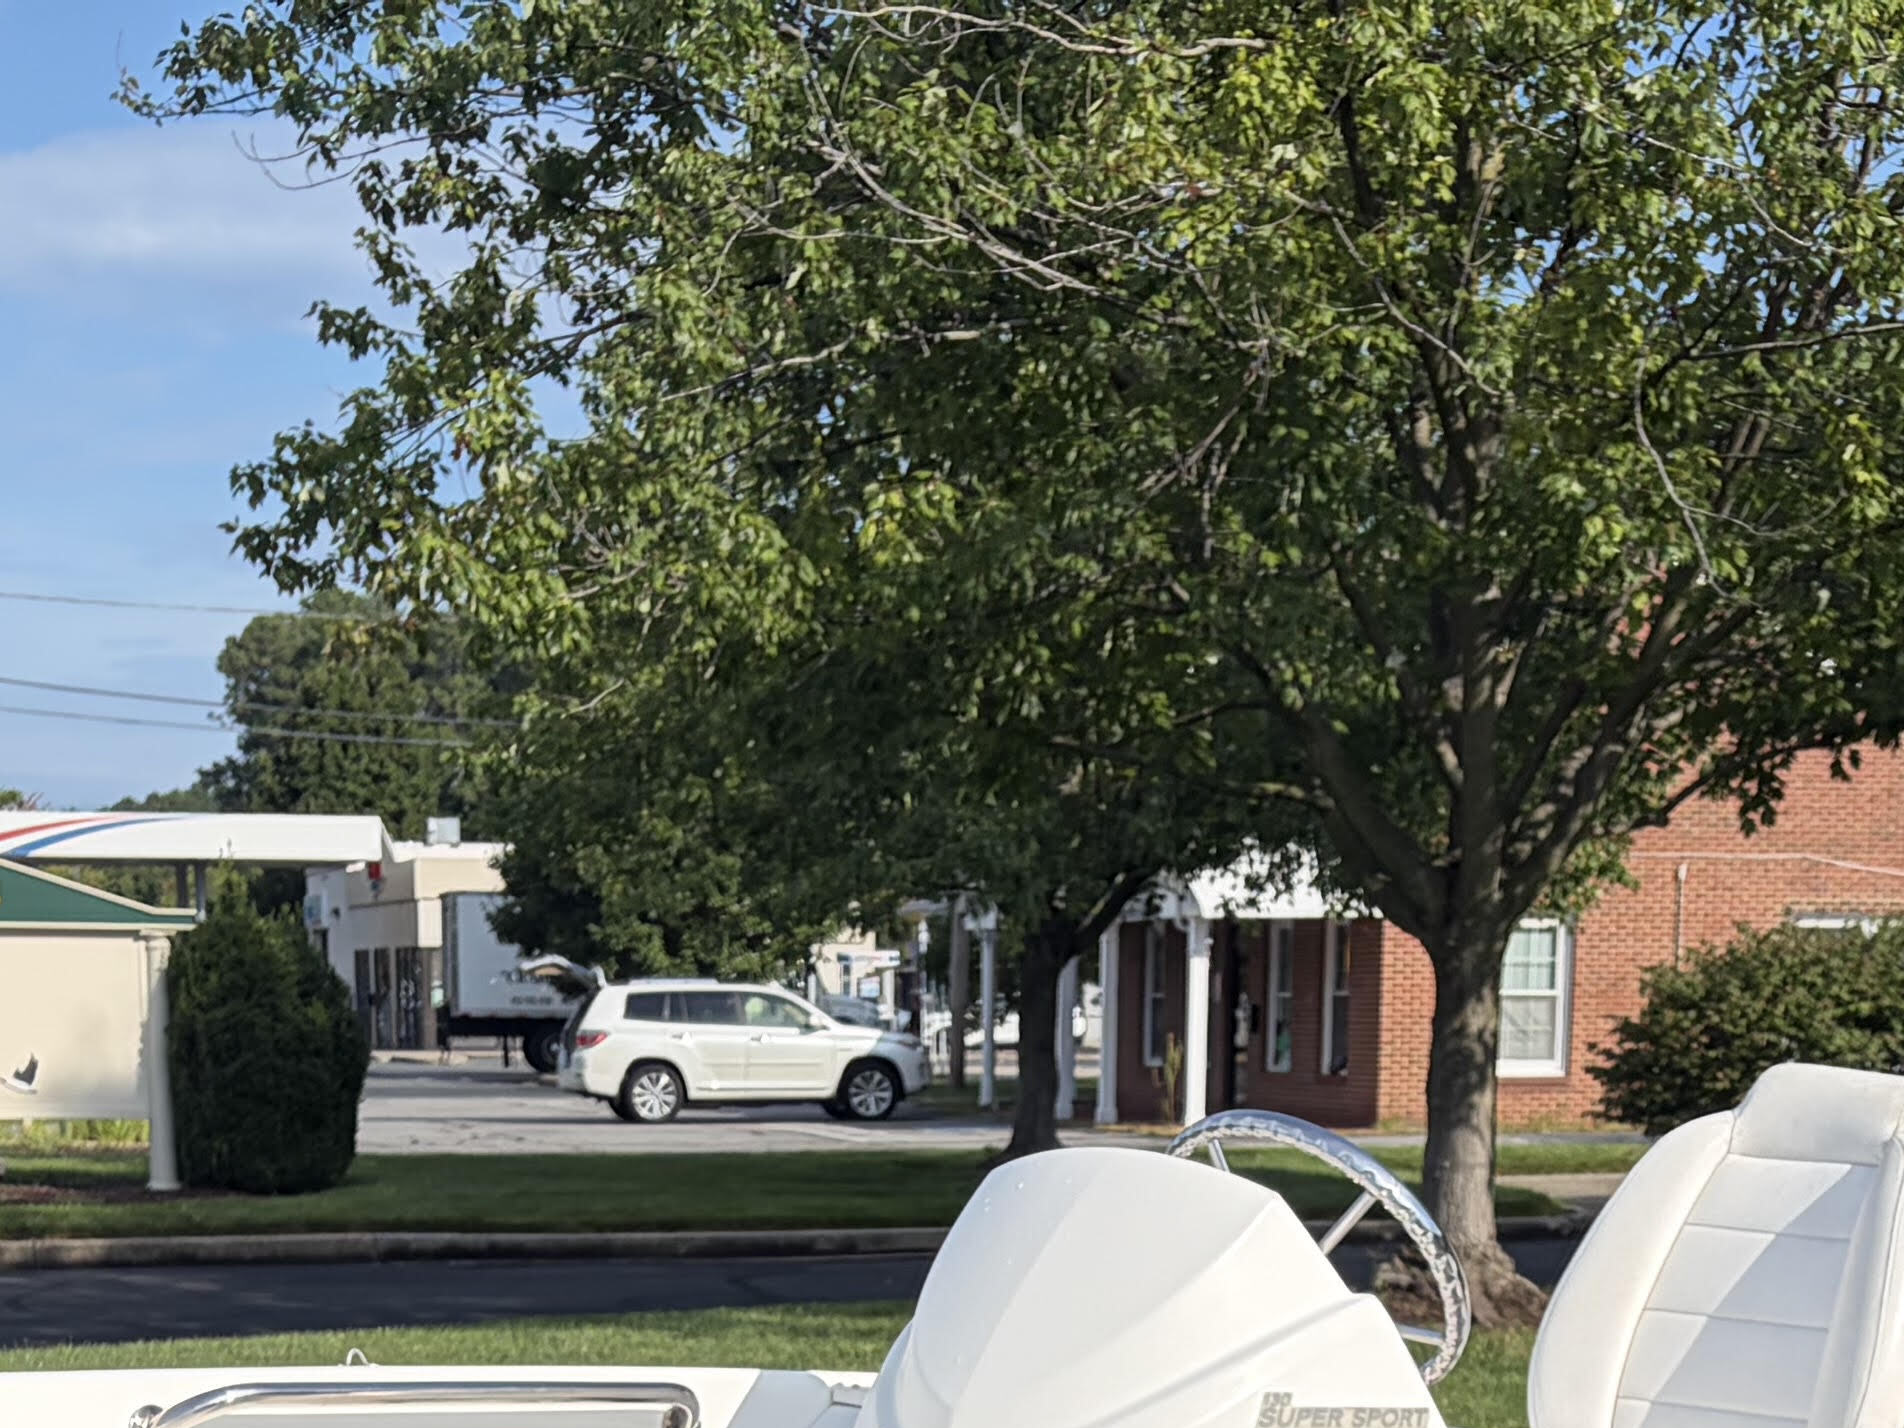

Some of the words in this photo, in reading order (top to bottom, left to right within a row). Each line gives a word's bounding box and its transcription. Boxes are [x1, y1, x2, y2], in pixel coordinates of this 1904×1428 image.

[1262, 1392, 1293, 1407] 130
[1257, 1407, 1344, 1428] SUPER
[1351, 1407, 1429, 1428] SPORT
